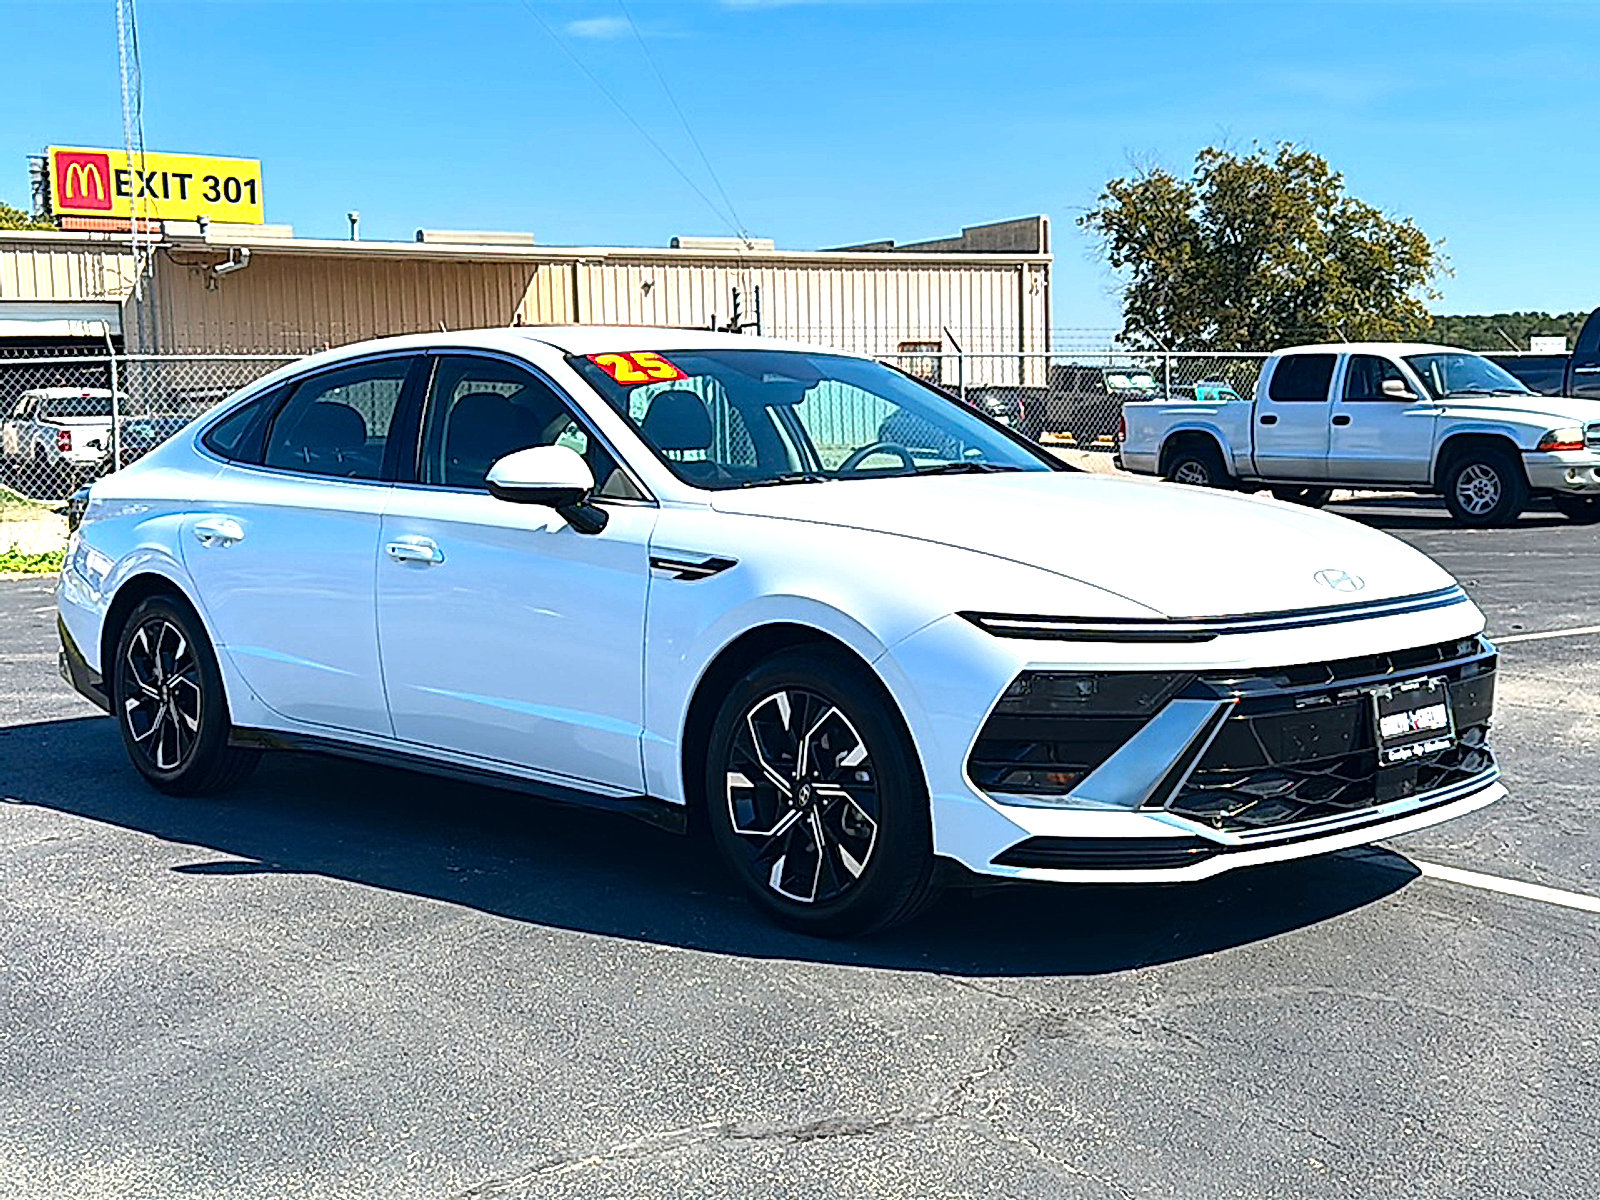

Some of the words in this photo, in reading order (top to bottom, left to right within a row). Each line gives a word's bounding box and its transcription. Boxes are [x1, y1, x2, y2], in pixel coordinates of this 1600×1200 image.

[115, 168, 193, 201] EXIT
[202, 175, 257, 205] 301
[595, 352, 678, 381] 25
